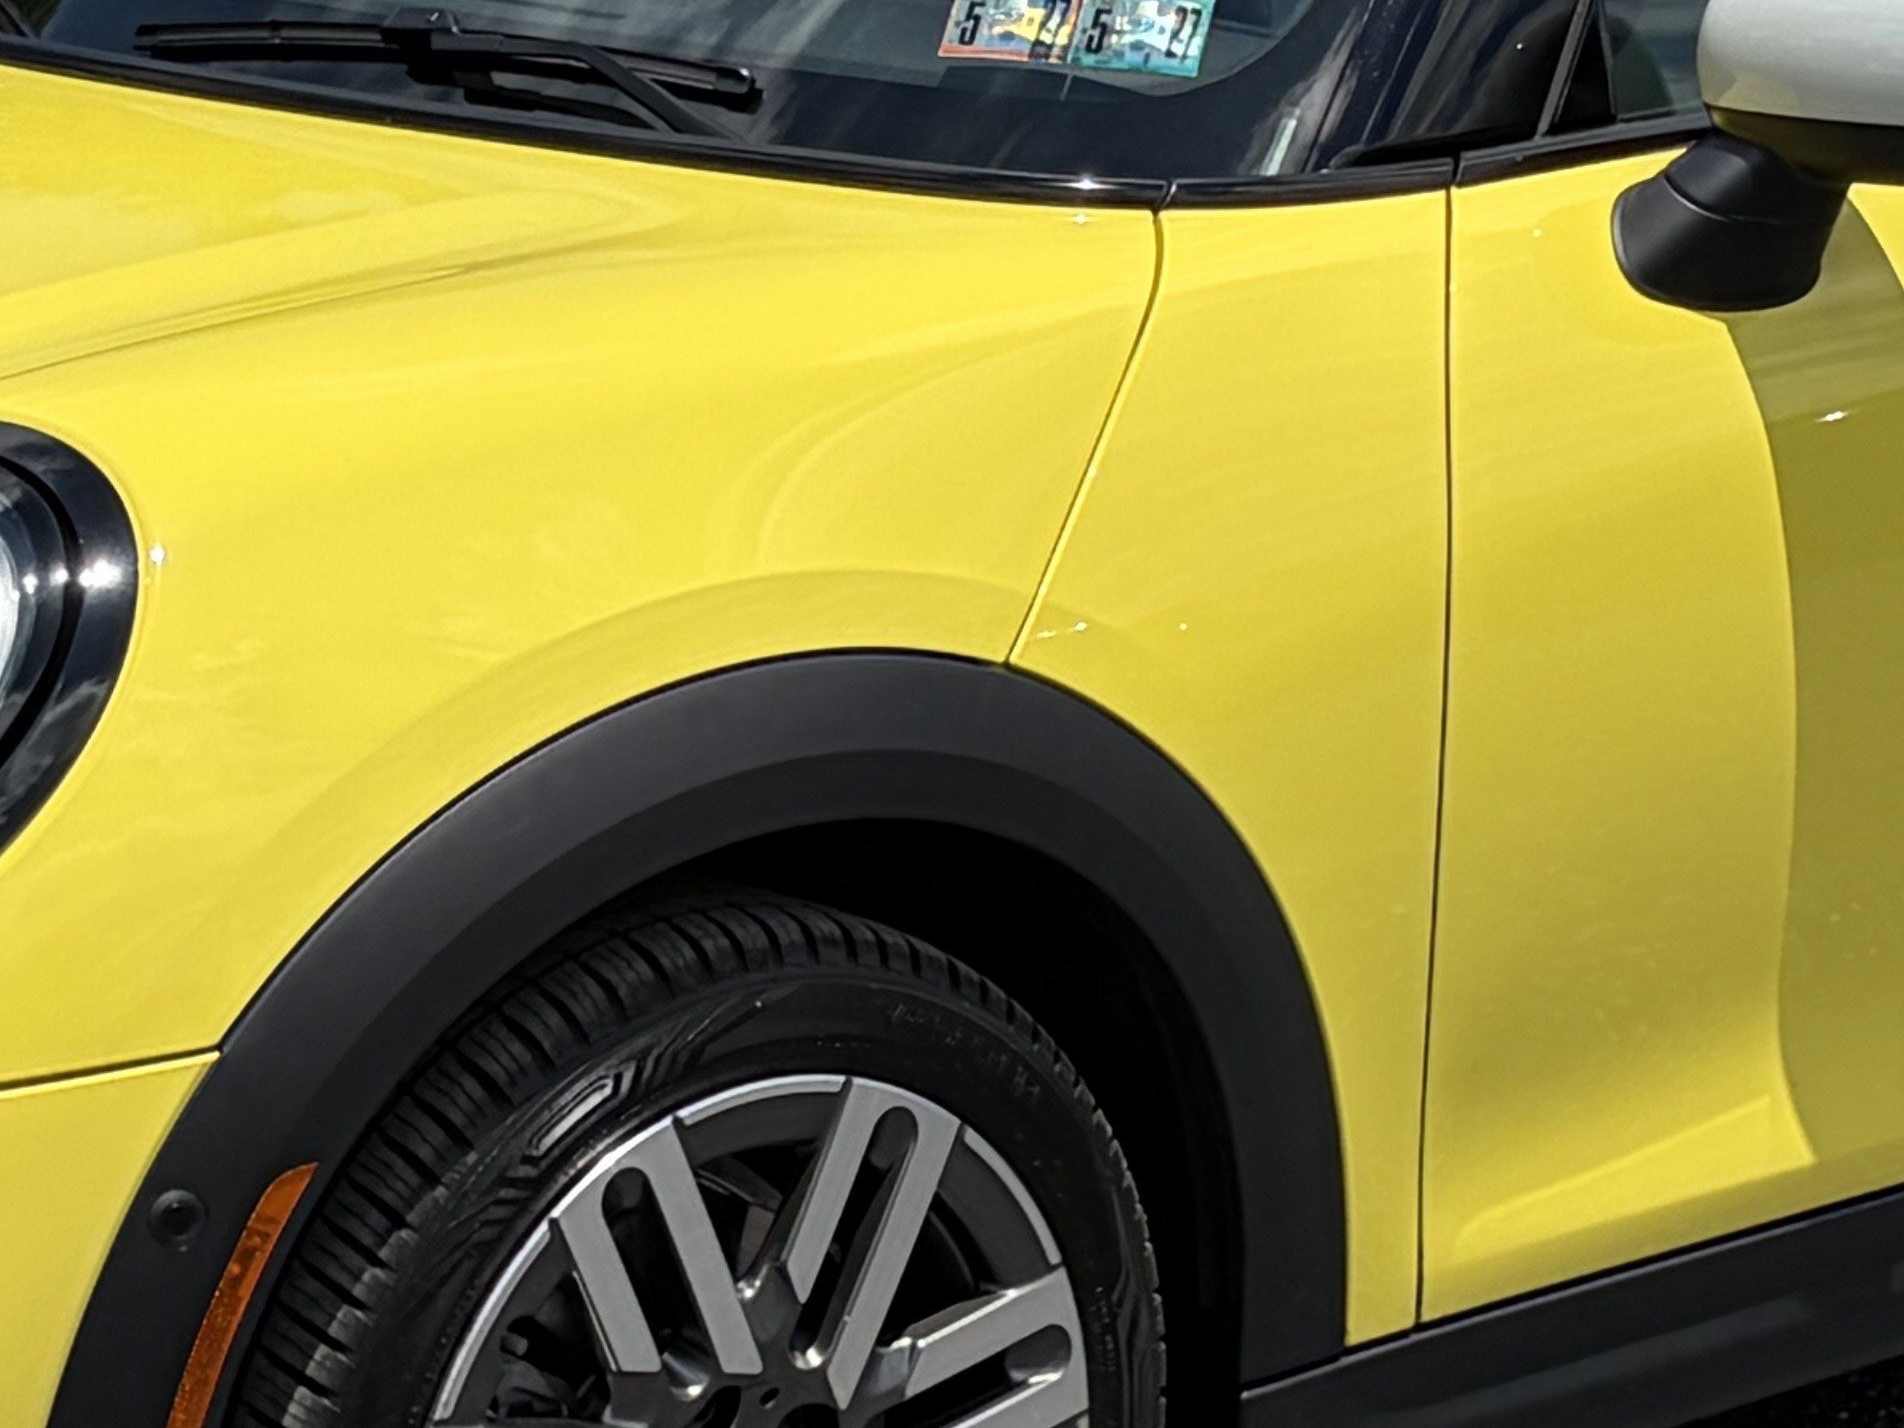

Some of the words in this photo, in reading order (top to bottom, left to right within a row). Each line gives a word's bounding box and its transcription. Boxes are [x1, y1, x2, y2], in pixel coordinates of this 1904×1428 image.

[958, 0, 987, 46] 5
[1085, 8, 1113, 54] 5
[1164, 5, 1203, 61] 27
